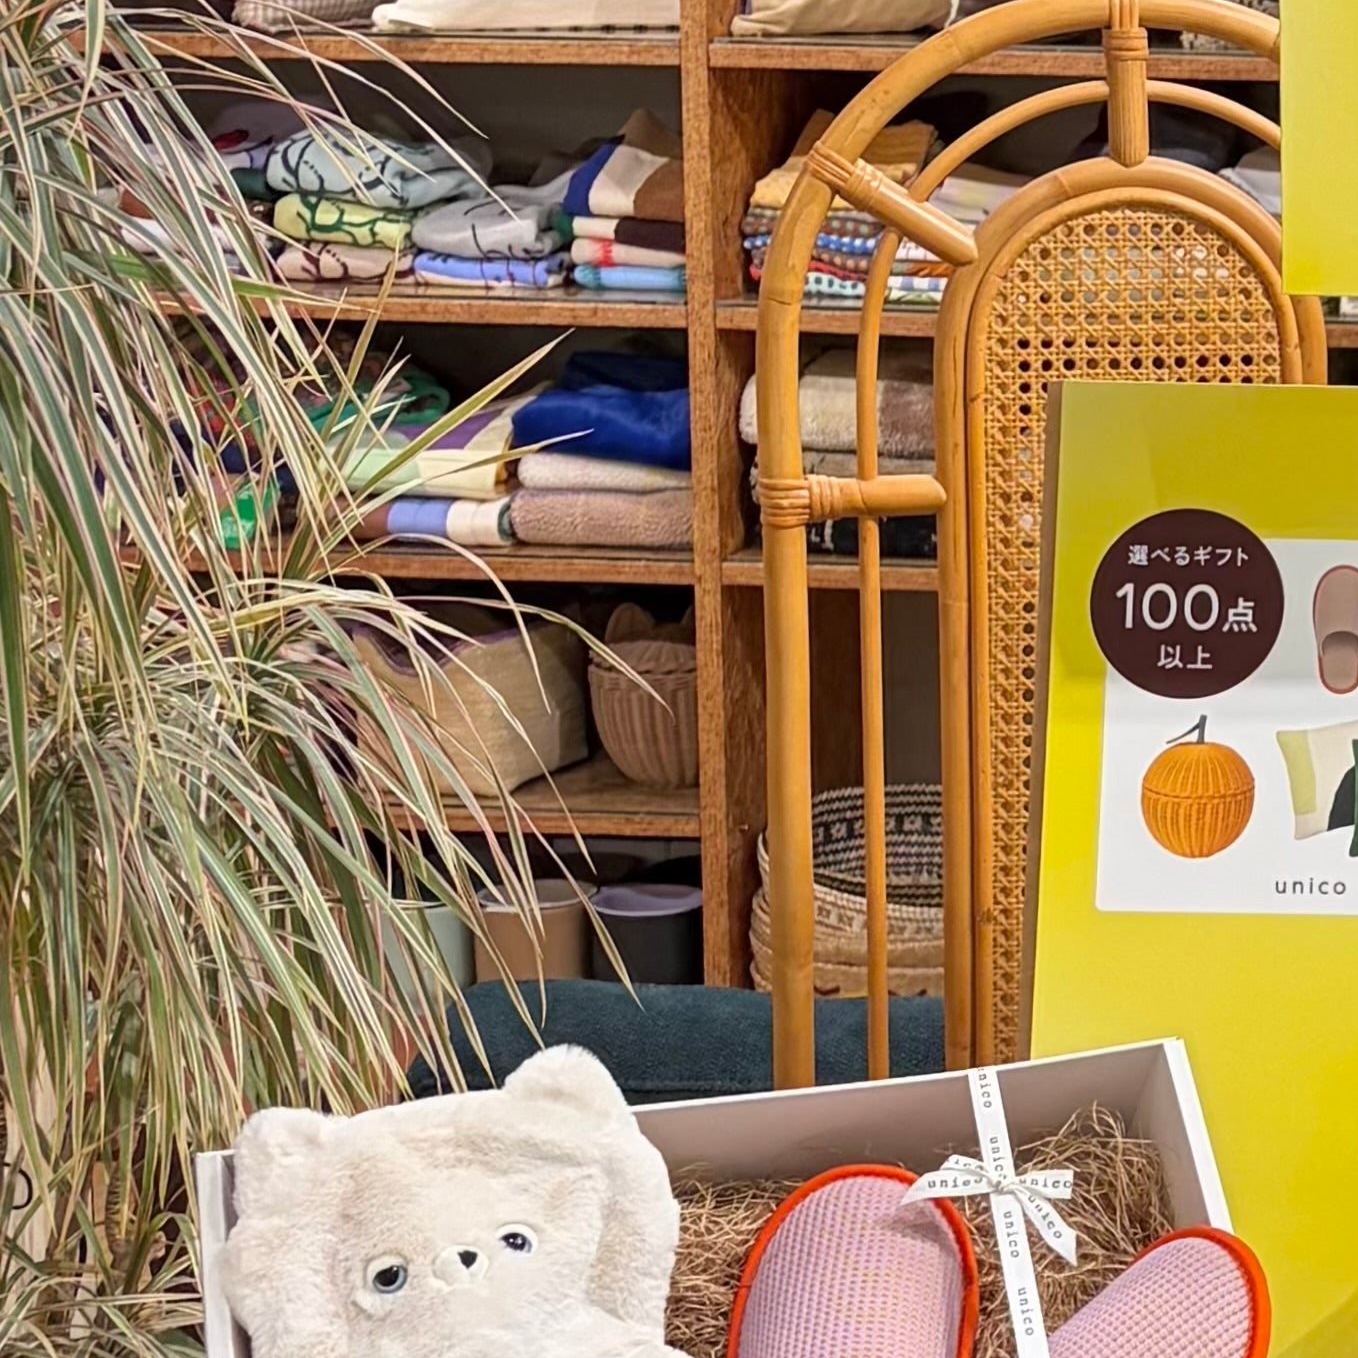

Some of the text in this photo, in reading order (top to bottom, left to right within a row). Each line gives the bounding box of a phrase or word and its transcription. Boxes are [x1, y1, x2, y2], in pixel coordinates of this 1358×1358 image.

[1127, 544, 1250, 567] 選べるギフト
[1114, 583, 1258, 633] 100点
[1156, 645, 1214, 671] 以上
[1275, 877, 1347, 896] unico
[977, 1067, 992, 1109] nico
[1003, 1210, 1020, 1259] unico
[1027, 1194, 1063, 1240] unico
[1017, 1286, 1034, 1337] unico
